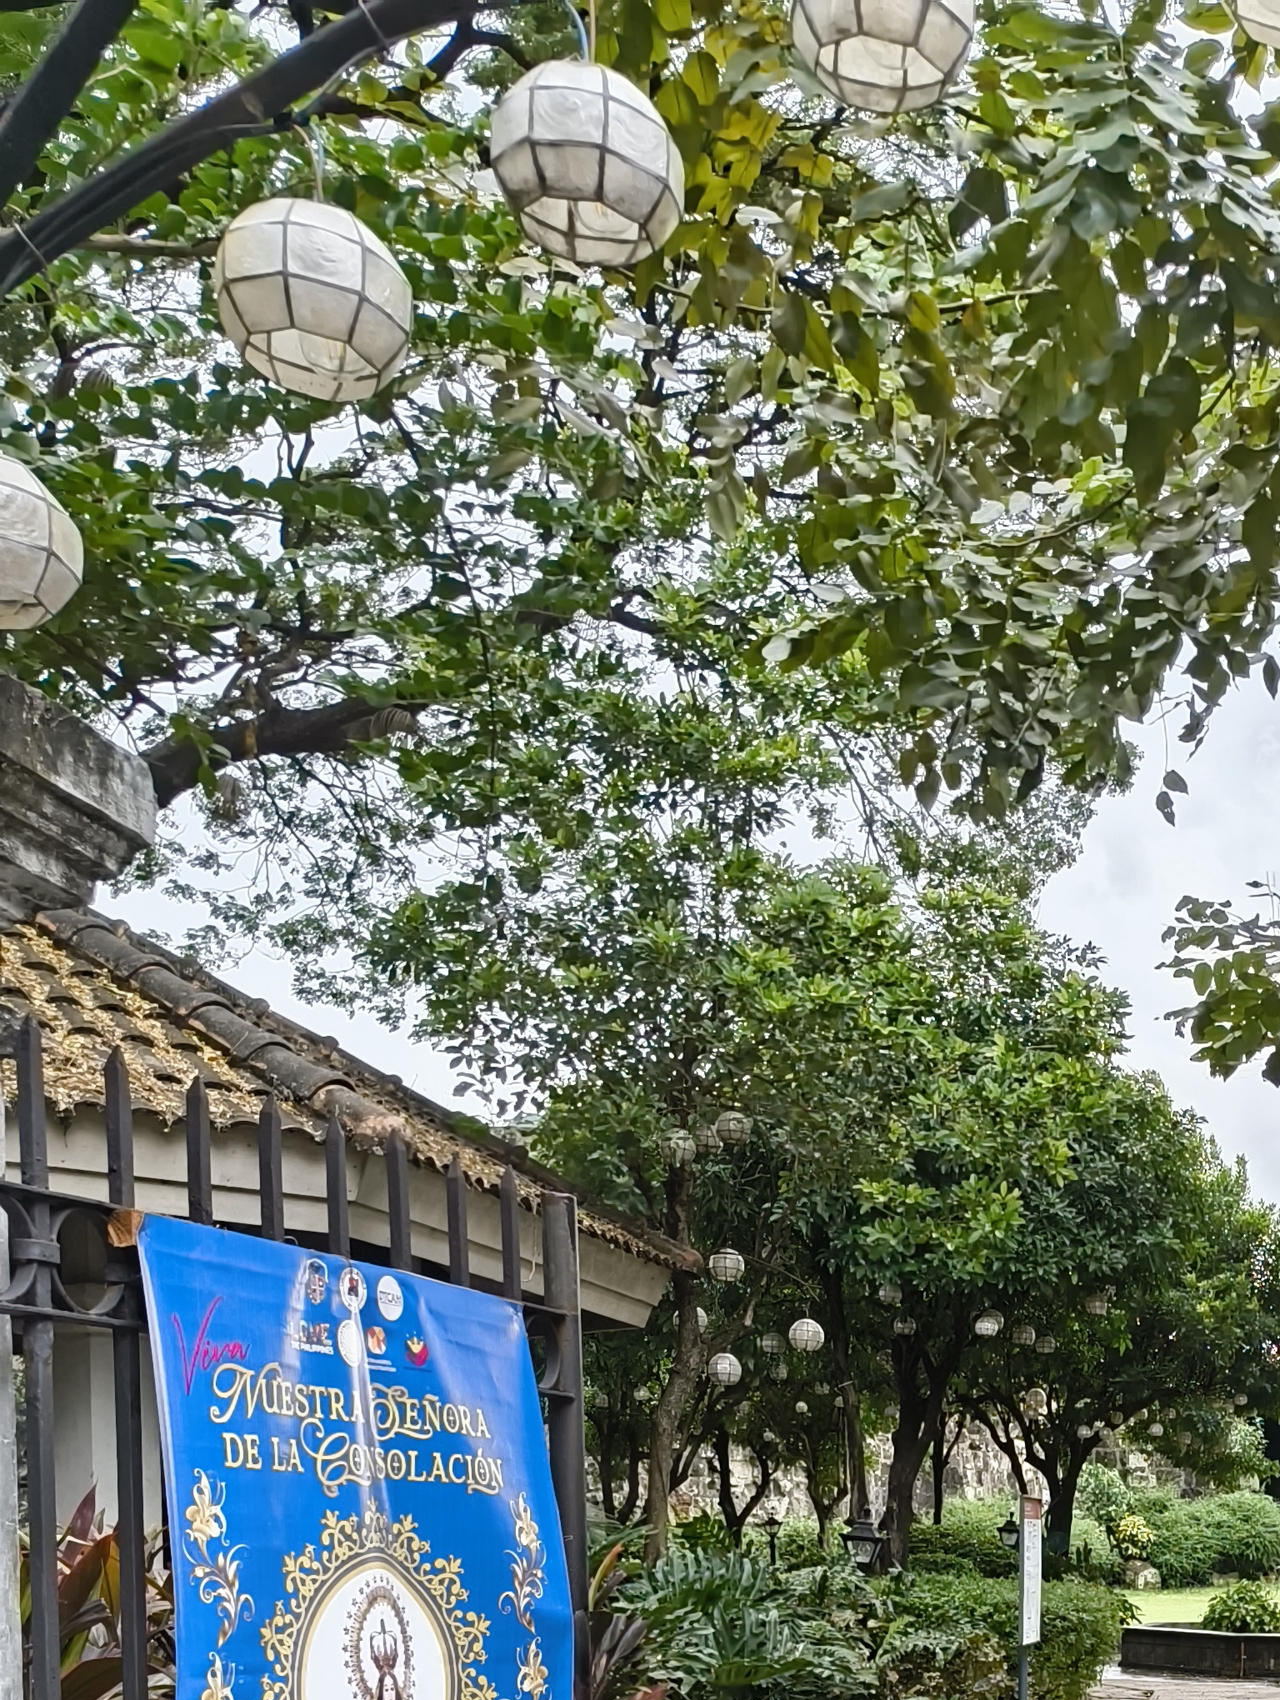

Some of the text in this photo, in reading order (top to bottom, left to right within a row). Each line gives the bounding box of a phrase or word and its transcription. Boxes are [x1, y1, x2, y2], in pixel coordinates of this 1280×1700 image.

[171, 1296, 250, 1396] Viva
[210, 1362, 492, 1441] NUESTRA SEÑORA
[222, 1418, 503, 1498] DE LA CONSOLACIÓN
